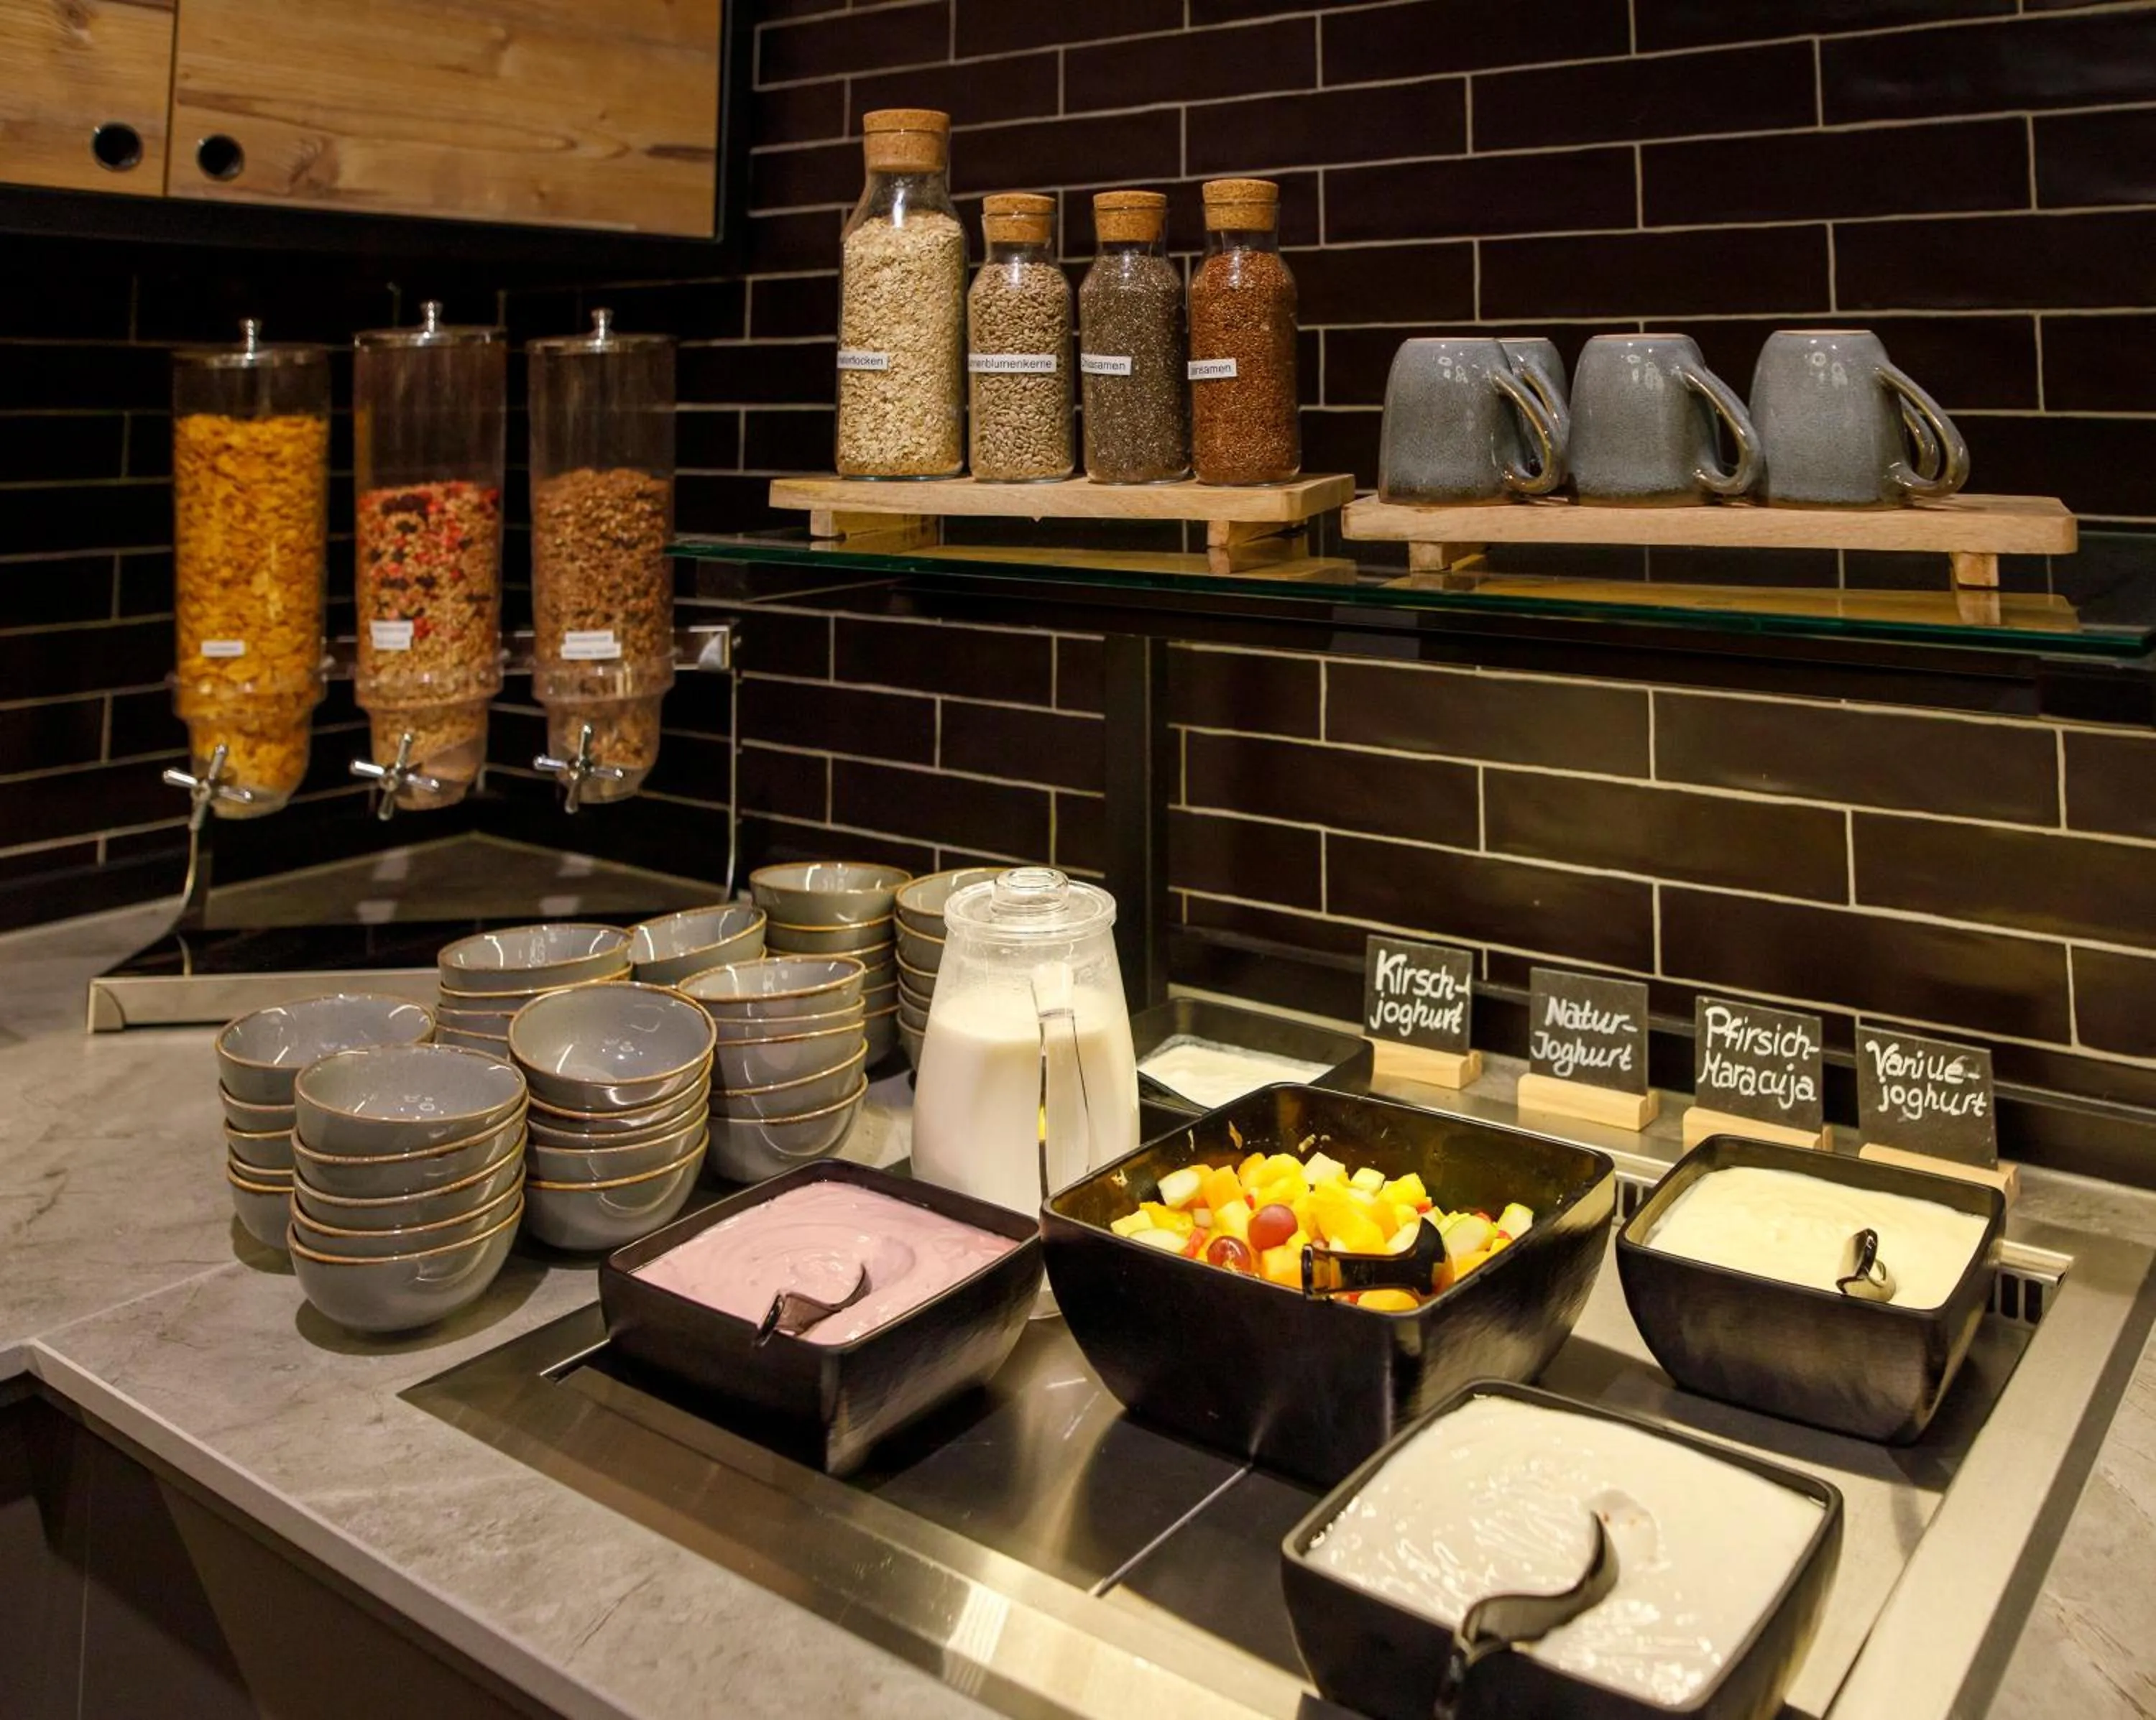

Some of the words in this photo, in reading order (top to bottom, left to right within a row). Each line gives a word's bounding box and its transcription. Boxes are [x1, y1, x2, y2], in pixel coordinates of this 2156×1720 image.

[1374, 949, 1470, 1001] Kirsch-
[1369, 991, 1464, 1036] joghurt
[1544, 996, 1638, 1035] Natur-
[1705, 1006, 1820, 1060] Pfirsich-
[1530, 1031, 1633, 1077] Joghurt
[1865, 1040, 1981, 1084] Vanille-
[1696, 1050, 1818, 1110] Maracuja
[1878, 1076, 1988, 1120] joghurt
